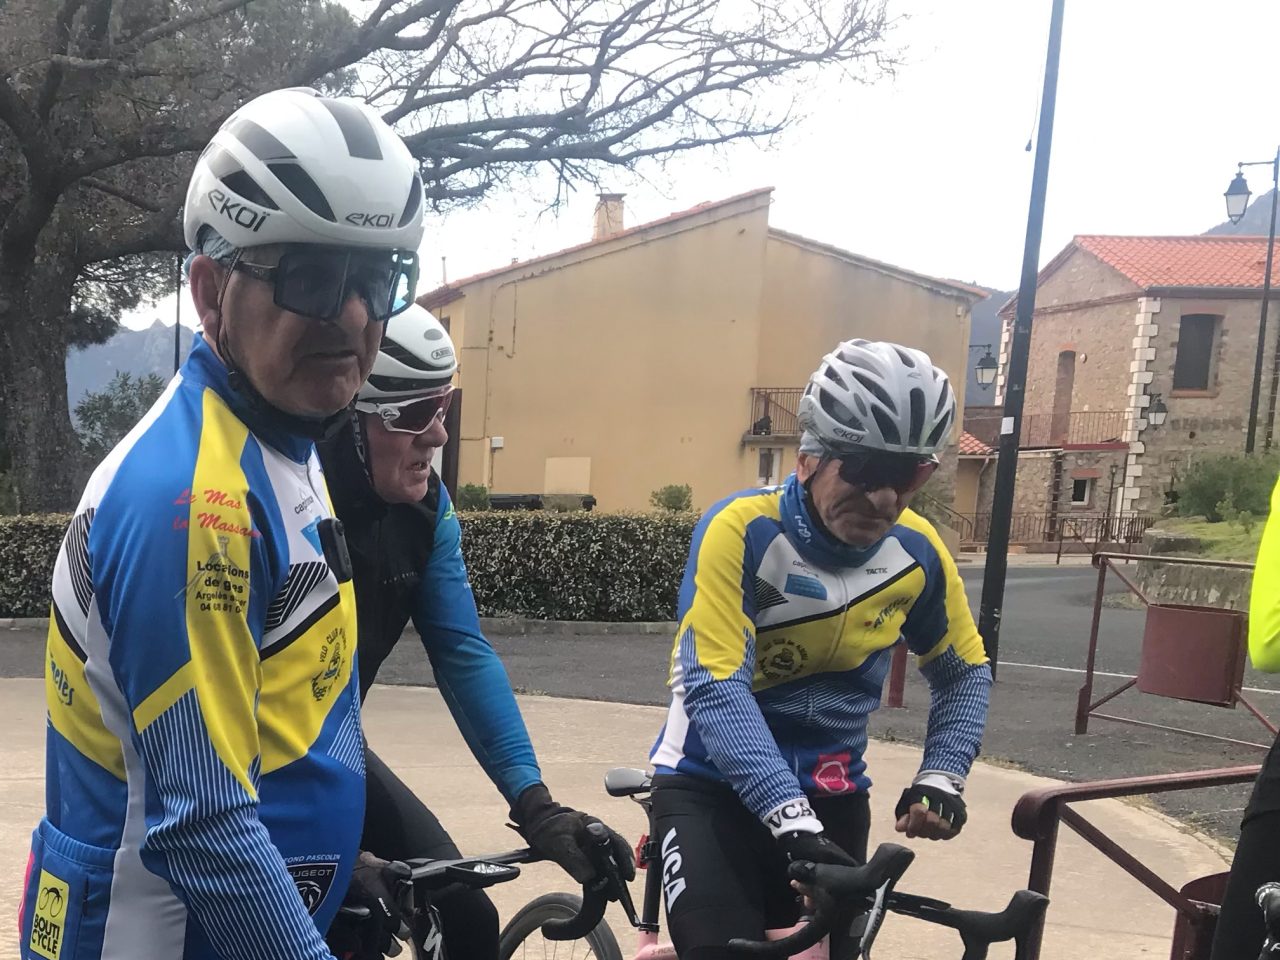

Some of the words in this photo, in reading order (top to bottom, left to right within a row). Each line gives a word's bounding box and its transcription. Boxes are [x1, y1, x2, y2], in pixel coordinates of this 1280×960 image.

[204, 489, 241, 509] Mas
[200, 602, 211, 612] 04
[768, 802, 813, 829] VCA
[661, 826, 687, 914] VCA
[34, 913, 60, 940] BOUTI
[31, 930, 58, 955] CYCLE
